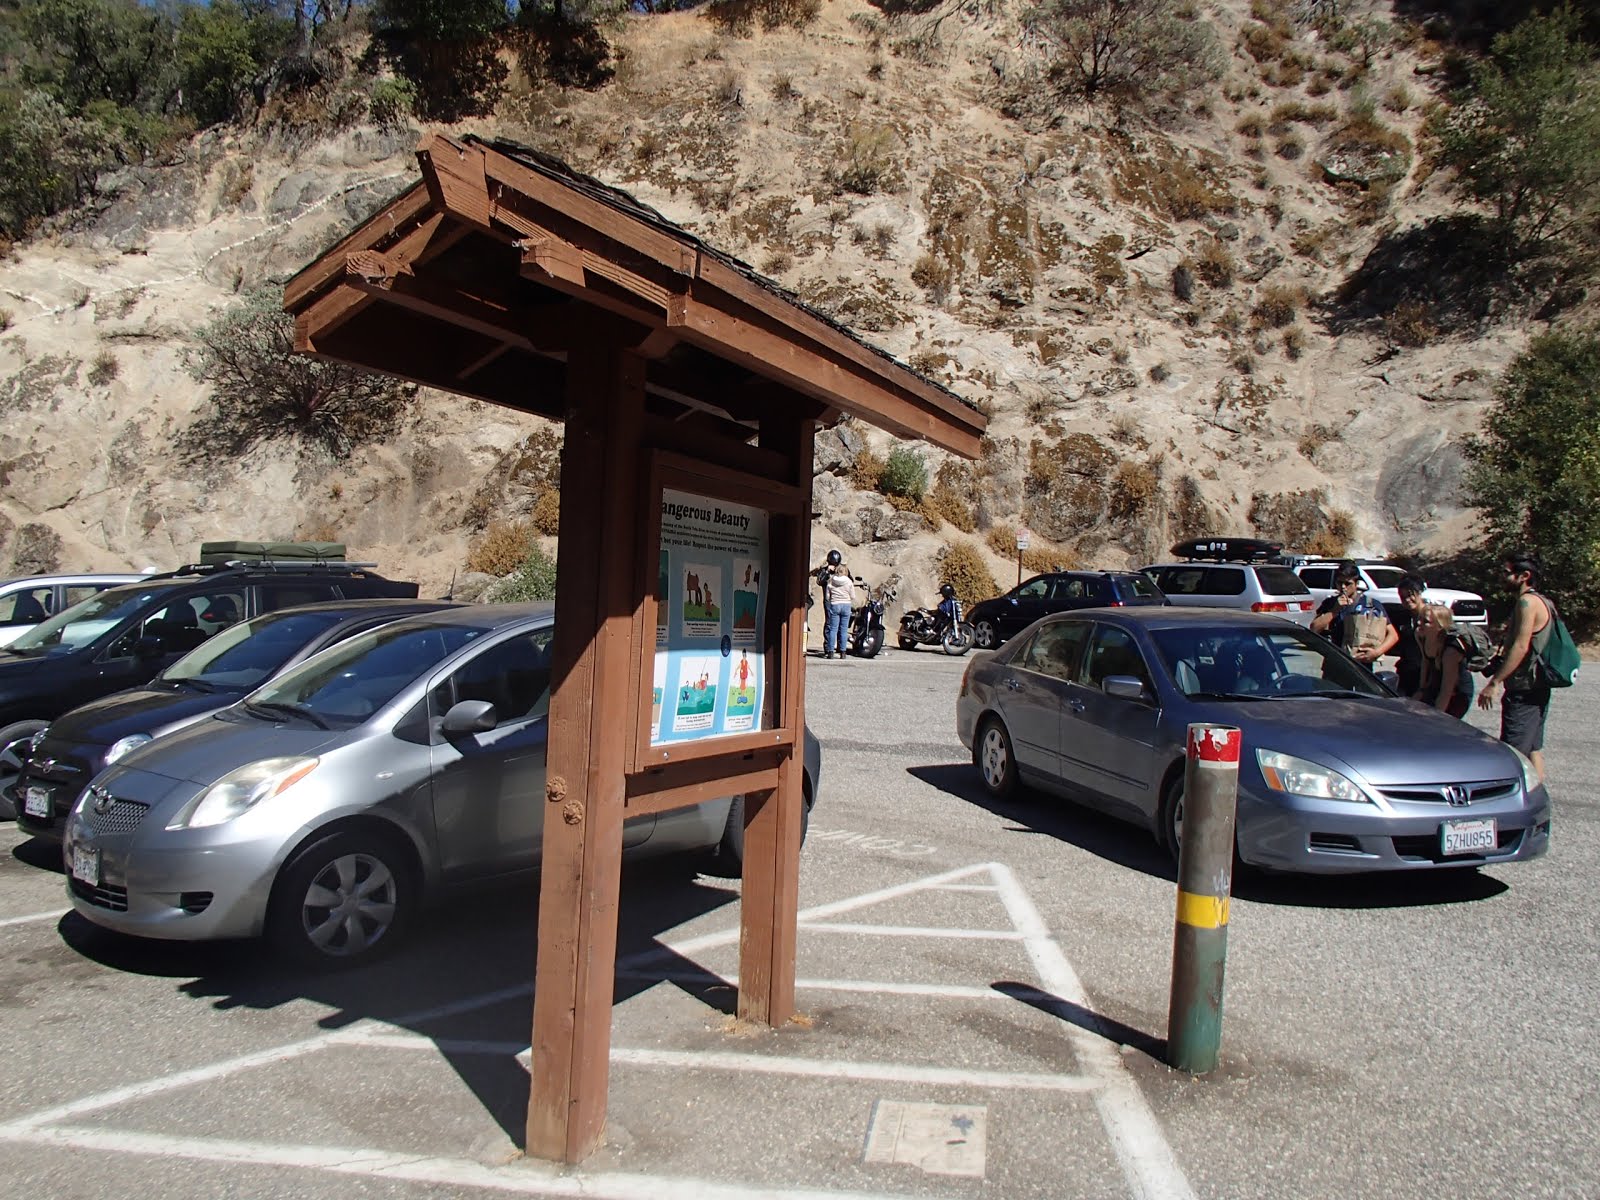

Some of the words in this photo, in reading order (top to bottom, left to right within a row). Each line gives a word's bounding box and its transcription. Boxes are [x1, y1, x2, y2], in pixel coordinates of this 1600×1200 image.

[662, 501, 711, 520] angerous
[713, 507, 751, 531] Beauty
[714, 544, 727, 552] power
[1454, 823, 1483, 832] California
[1446, 829, 1493, 850] 5ZHU855
